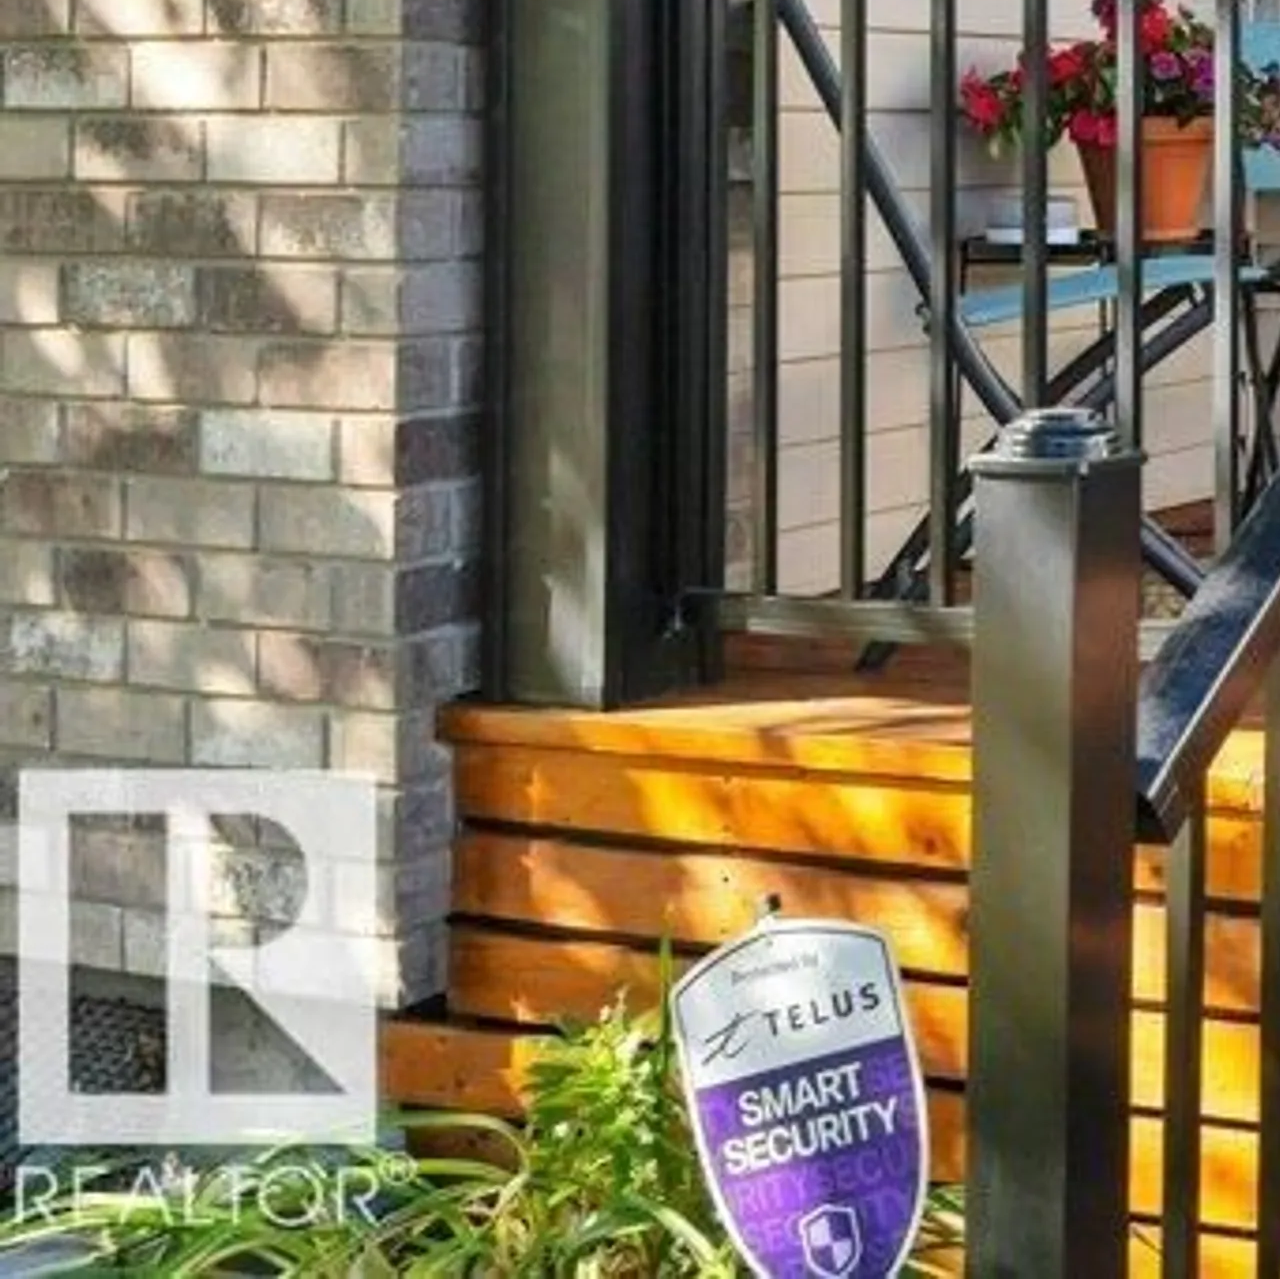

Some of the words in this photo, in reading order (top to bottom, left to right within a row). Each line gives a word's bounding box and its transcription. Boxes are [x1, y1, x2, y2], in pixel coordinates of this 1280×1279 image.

[762, 982, 882, 1037] TELUS
[737, 1060, 863, 1127] SMART
[722, 1096, 899, 1176] SECURITY
